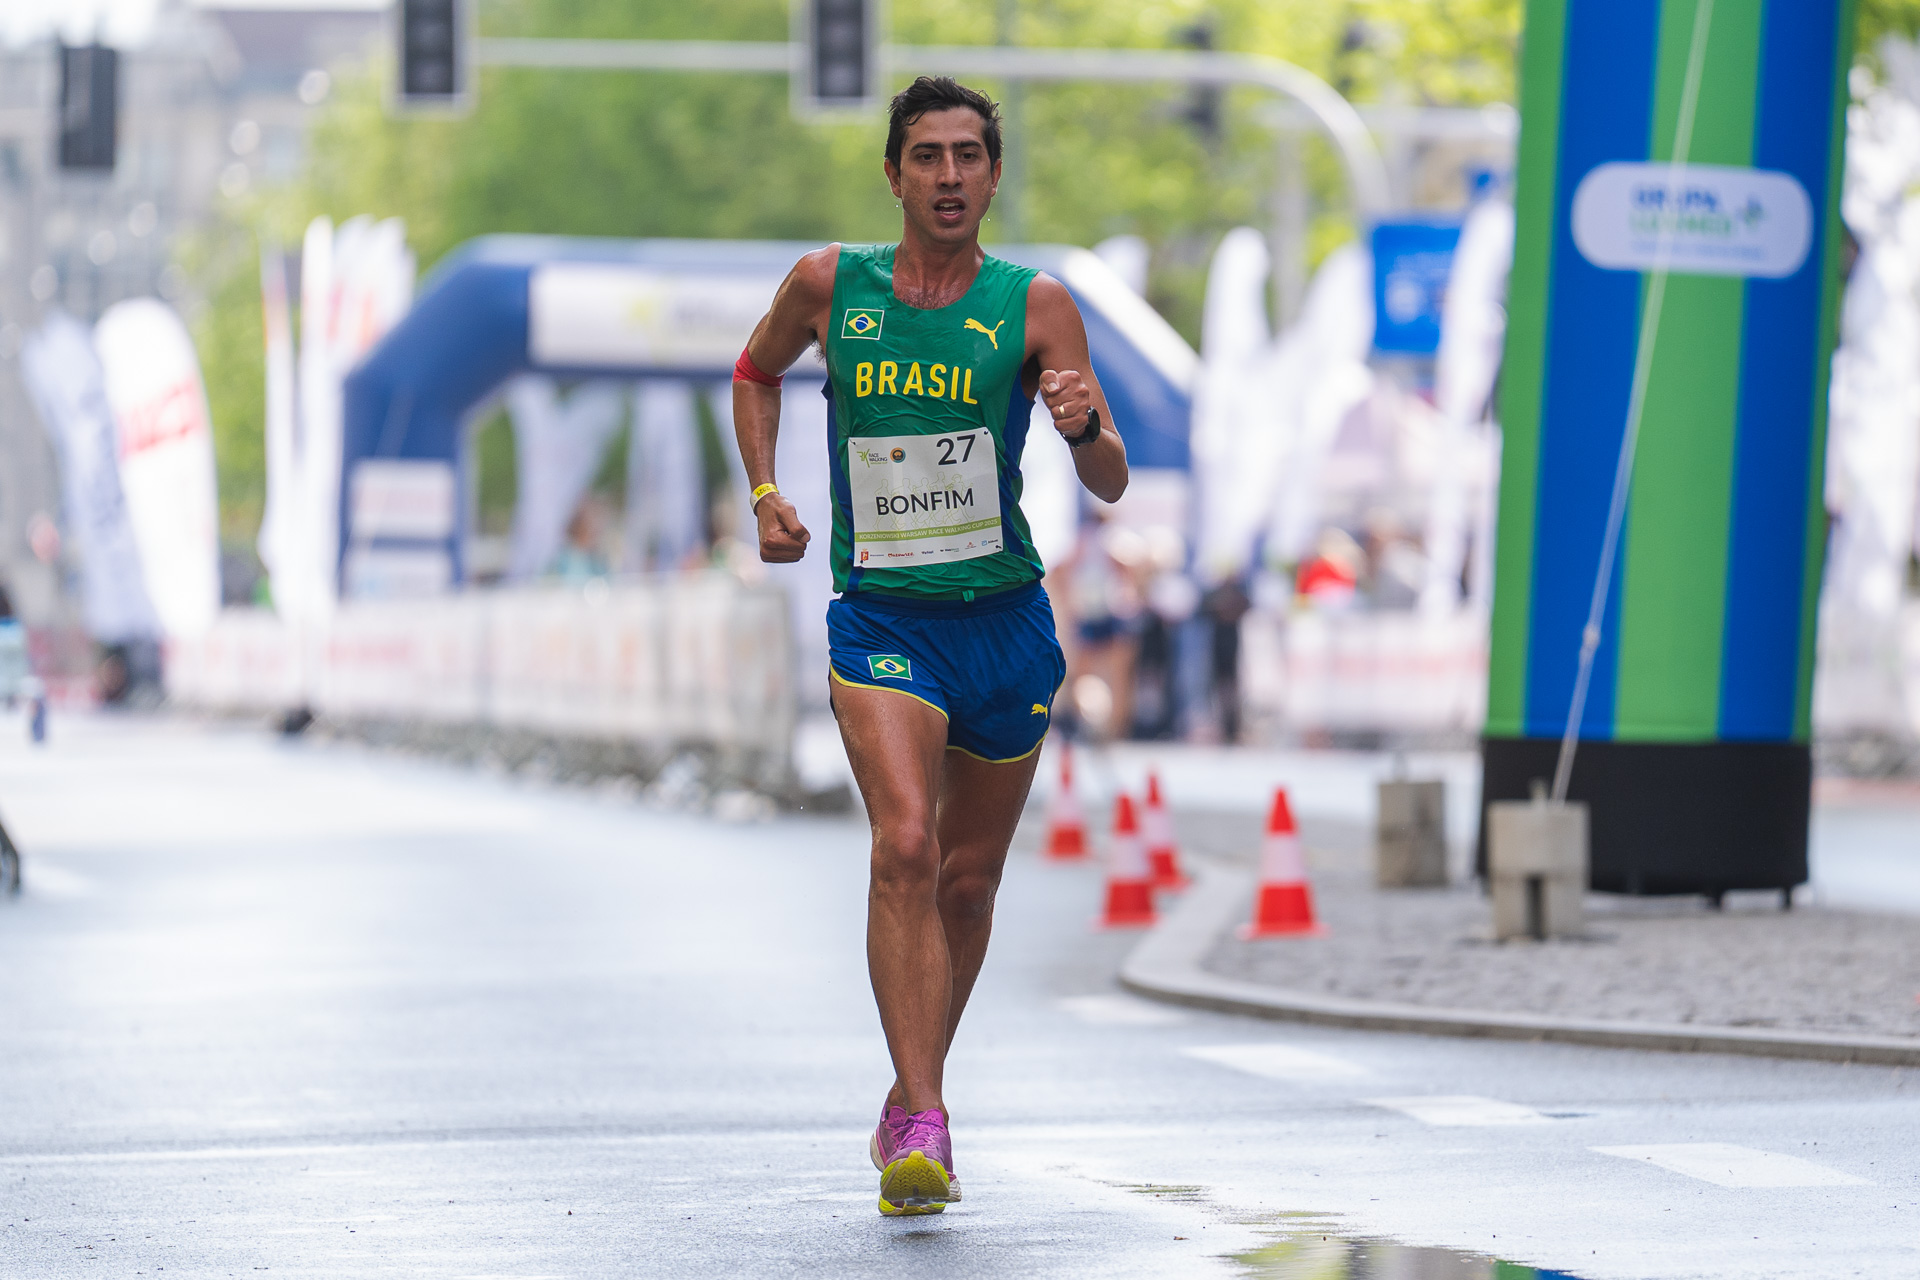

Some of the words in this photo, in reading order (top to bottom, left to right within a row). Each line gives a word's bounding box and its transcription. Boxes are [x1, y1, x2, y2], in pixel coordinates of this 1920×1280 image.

[856, 361, 978, 405] BRASIL
[936, 434, 976, 465] 27
[876, 488, 974, 516] BONFIM
[900, 530, 927, 538] WARSAW
[944, 524, 972, 534] WALKING
